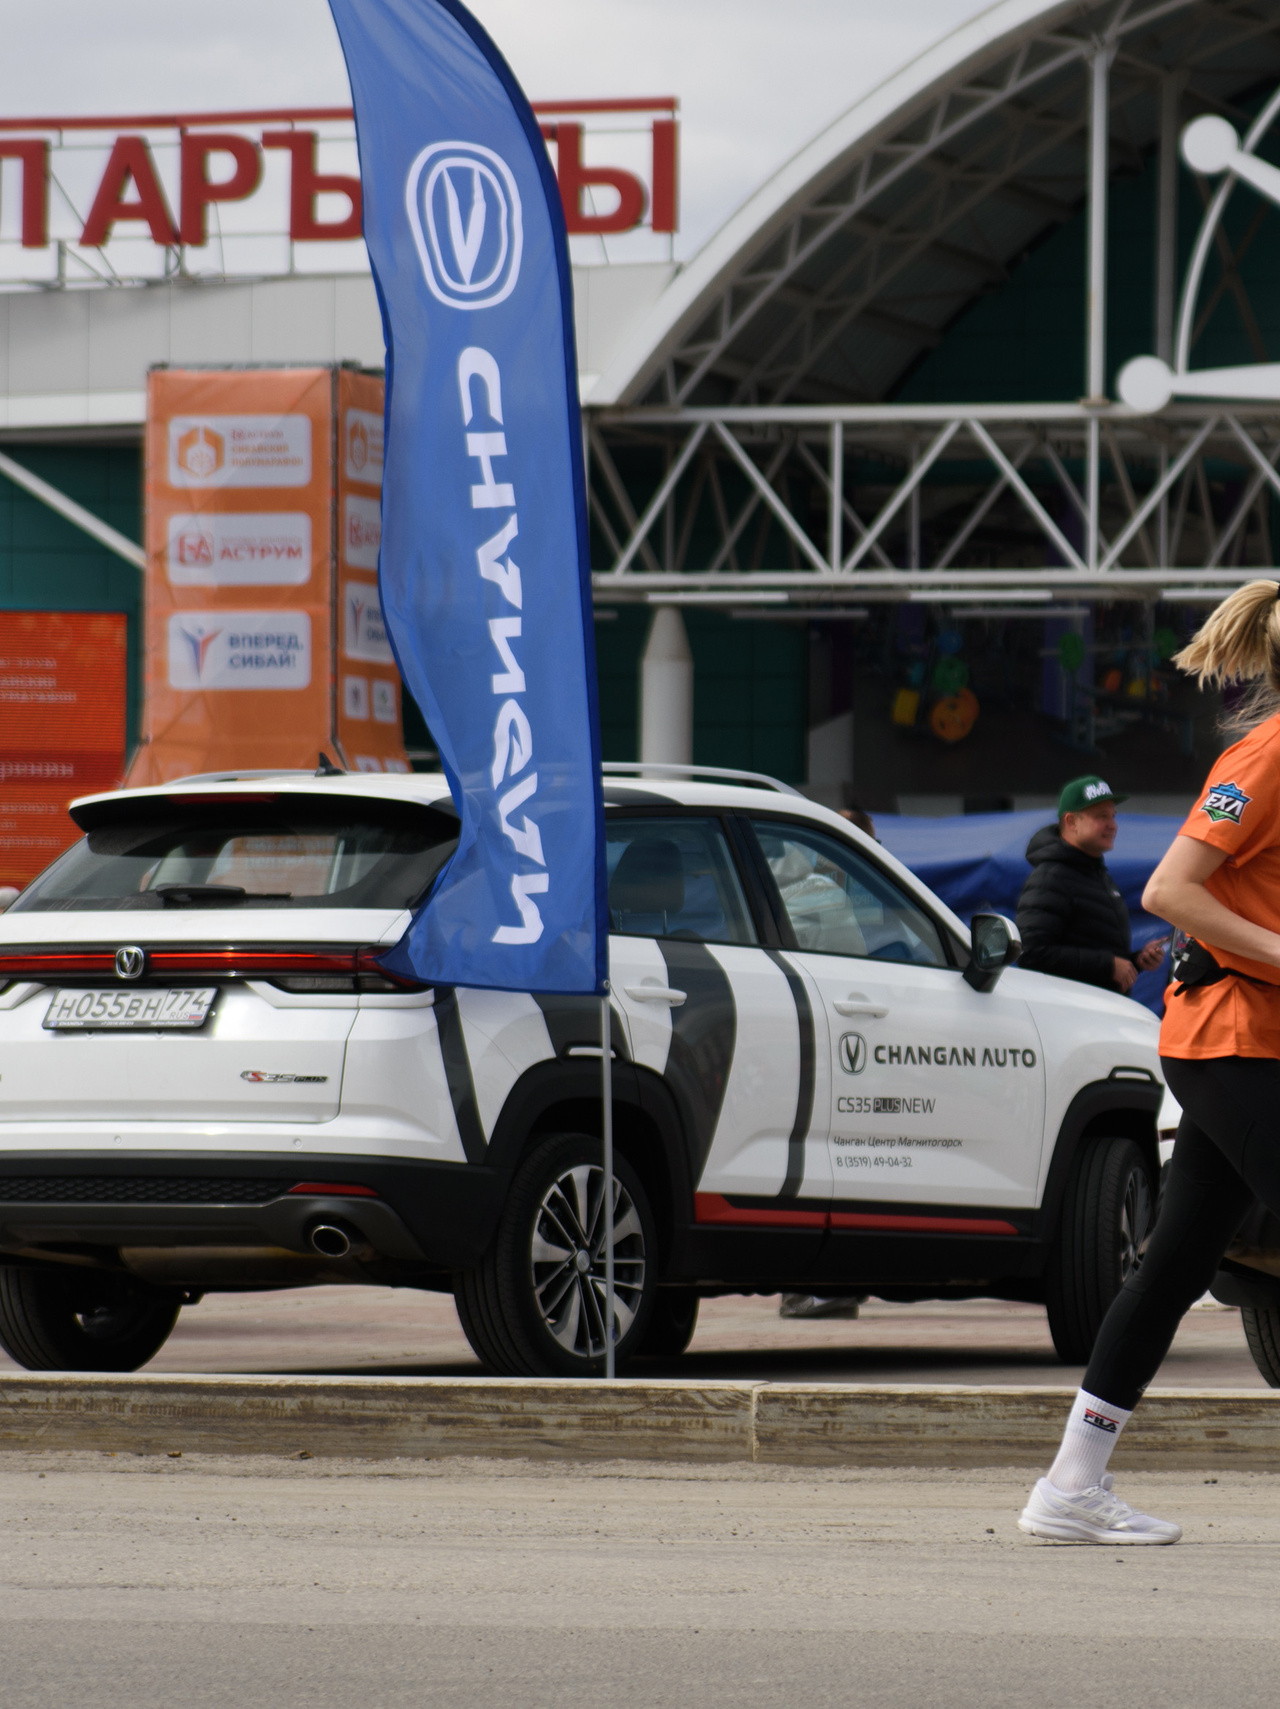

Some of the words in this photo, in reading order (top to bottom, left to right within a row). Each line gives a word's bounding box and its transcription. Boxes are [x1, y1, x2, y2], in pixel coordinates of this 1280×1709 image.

[220, 545, 303, 560] АСТРУМ
[874, 1045, 977, 1067] CHANGAN
[982, 1046, 1037, 1069] AUTO
[837, 1097, 871, 1114] CS35
[872, 1097, 901, 1114] PLUS
[901, 1098, 937, 1114] NEW
[833, 1136, 866, 1148] Чанган
[867, 1136, 896, 1149] Центр
[897, 1137, 964, 1149] Магнитогорск
[836, 1156, 843, 1168] 8
[844, 1156, 872, 1169] (3519)
[873, 1156, 913, 1168] 49-04-32
[1083, 1412, 1118, 1431] FILA
